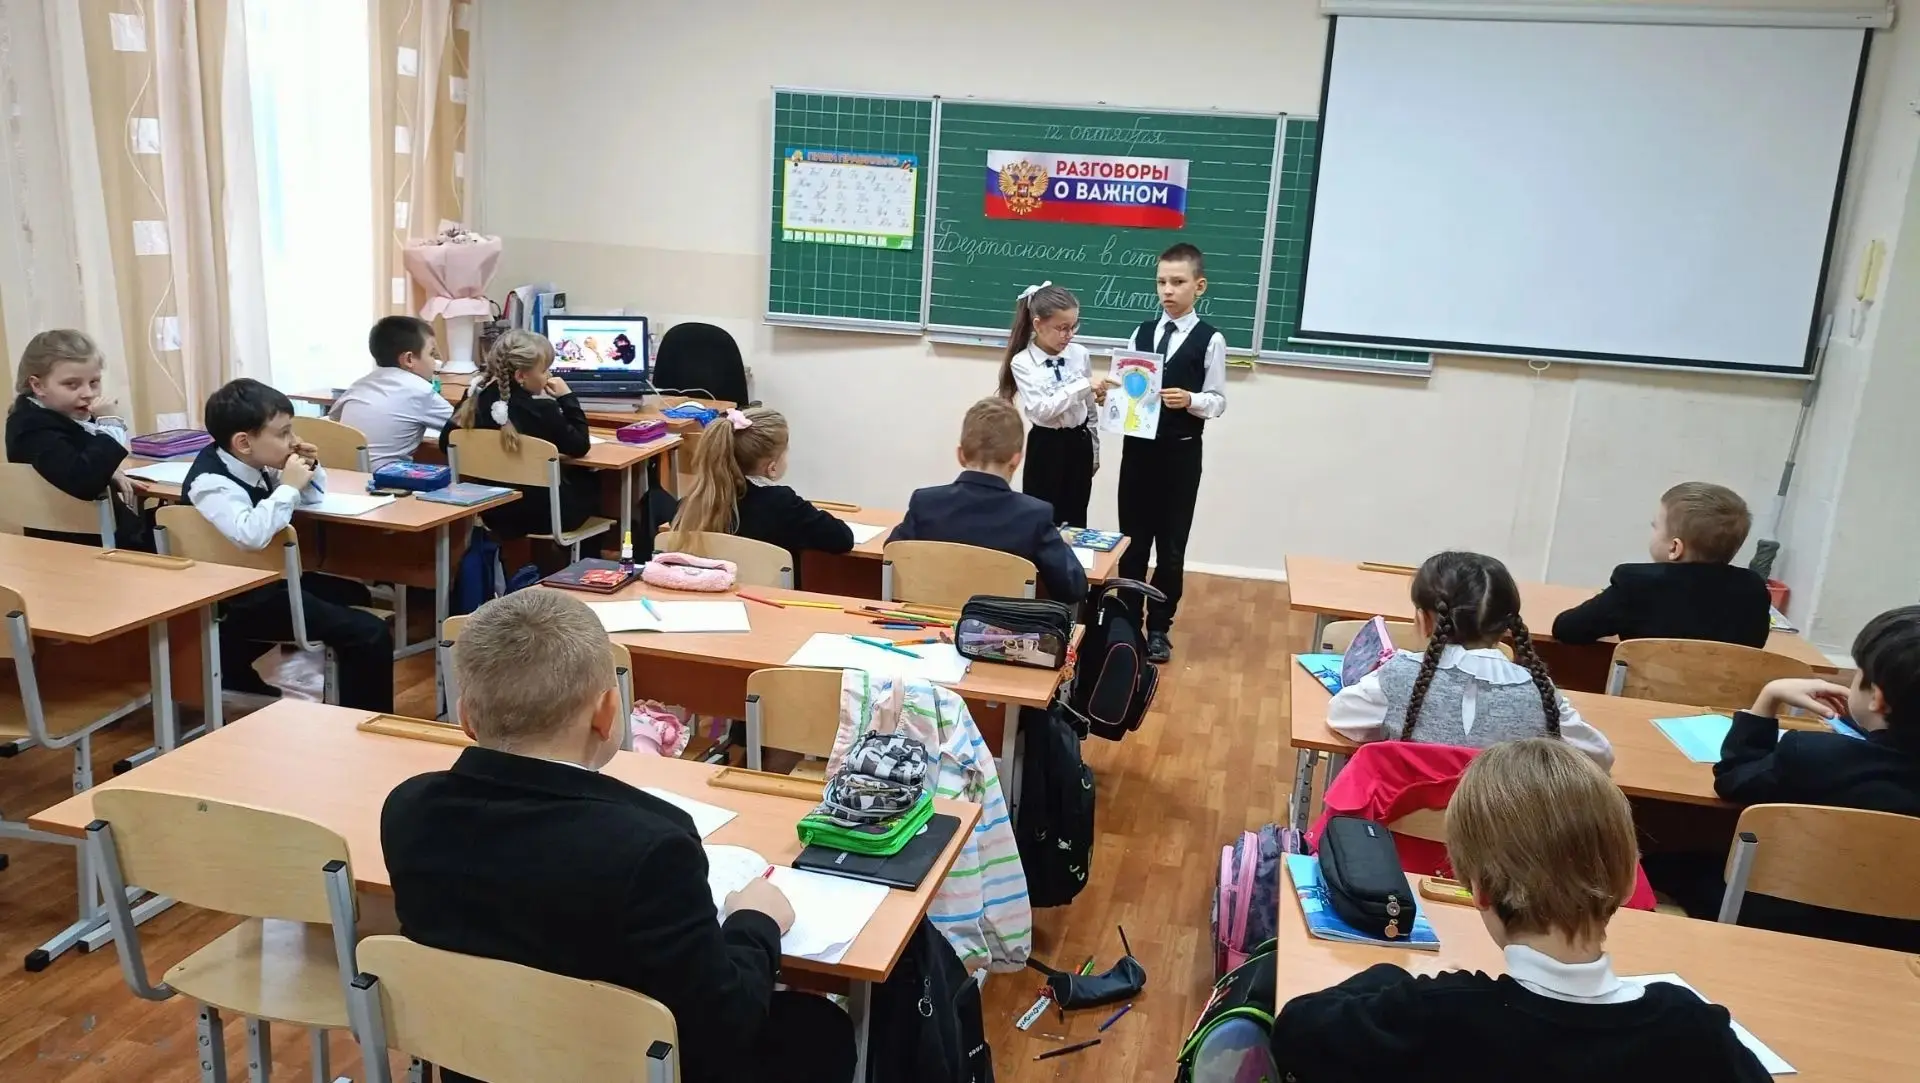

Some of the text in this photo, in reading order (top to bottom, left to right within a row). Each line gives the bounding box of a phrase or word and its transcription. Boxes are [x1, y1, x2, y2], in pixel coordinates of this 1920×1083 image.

[1044, 124, 1062, 141] 12
[1056, 160, 1169, 181] РАЗГОВОРЫ
[1054, 181, 1168, 204] О ВАЖНОМ
[936, 219, 1087, 265] Безопасность
[1099, 234, 1117, 265] в
[1120, 249, 1161, 267] сет
